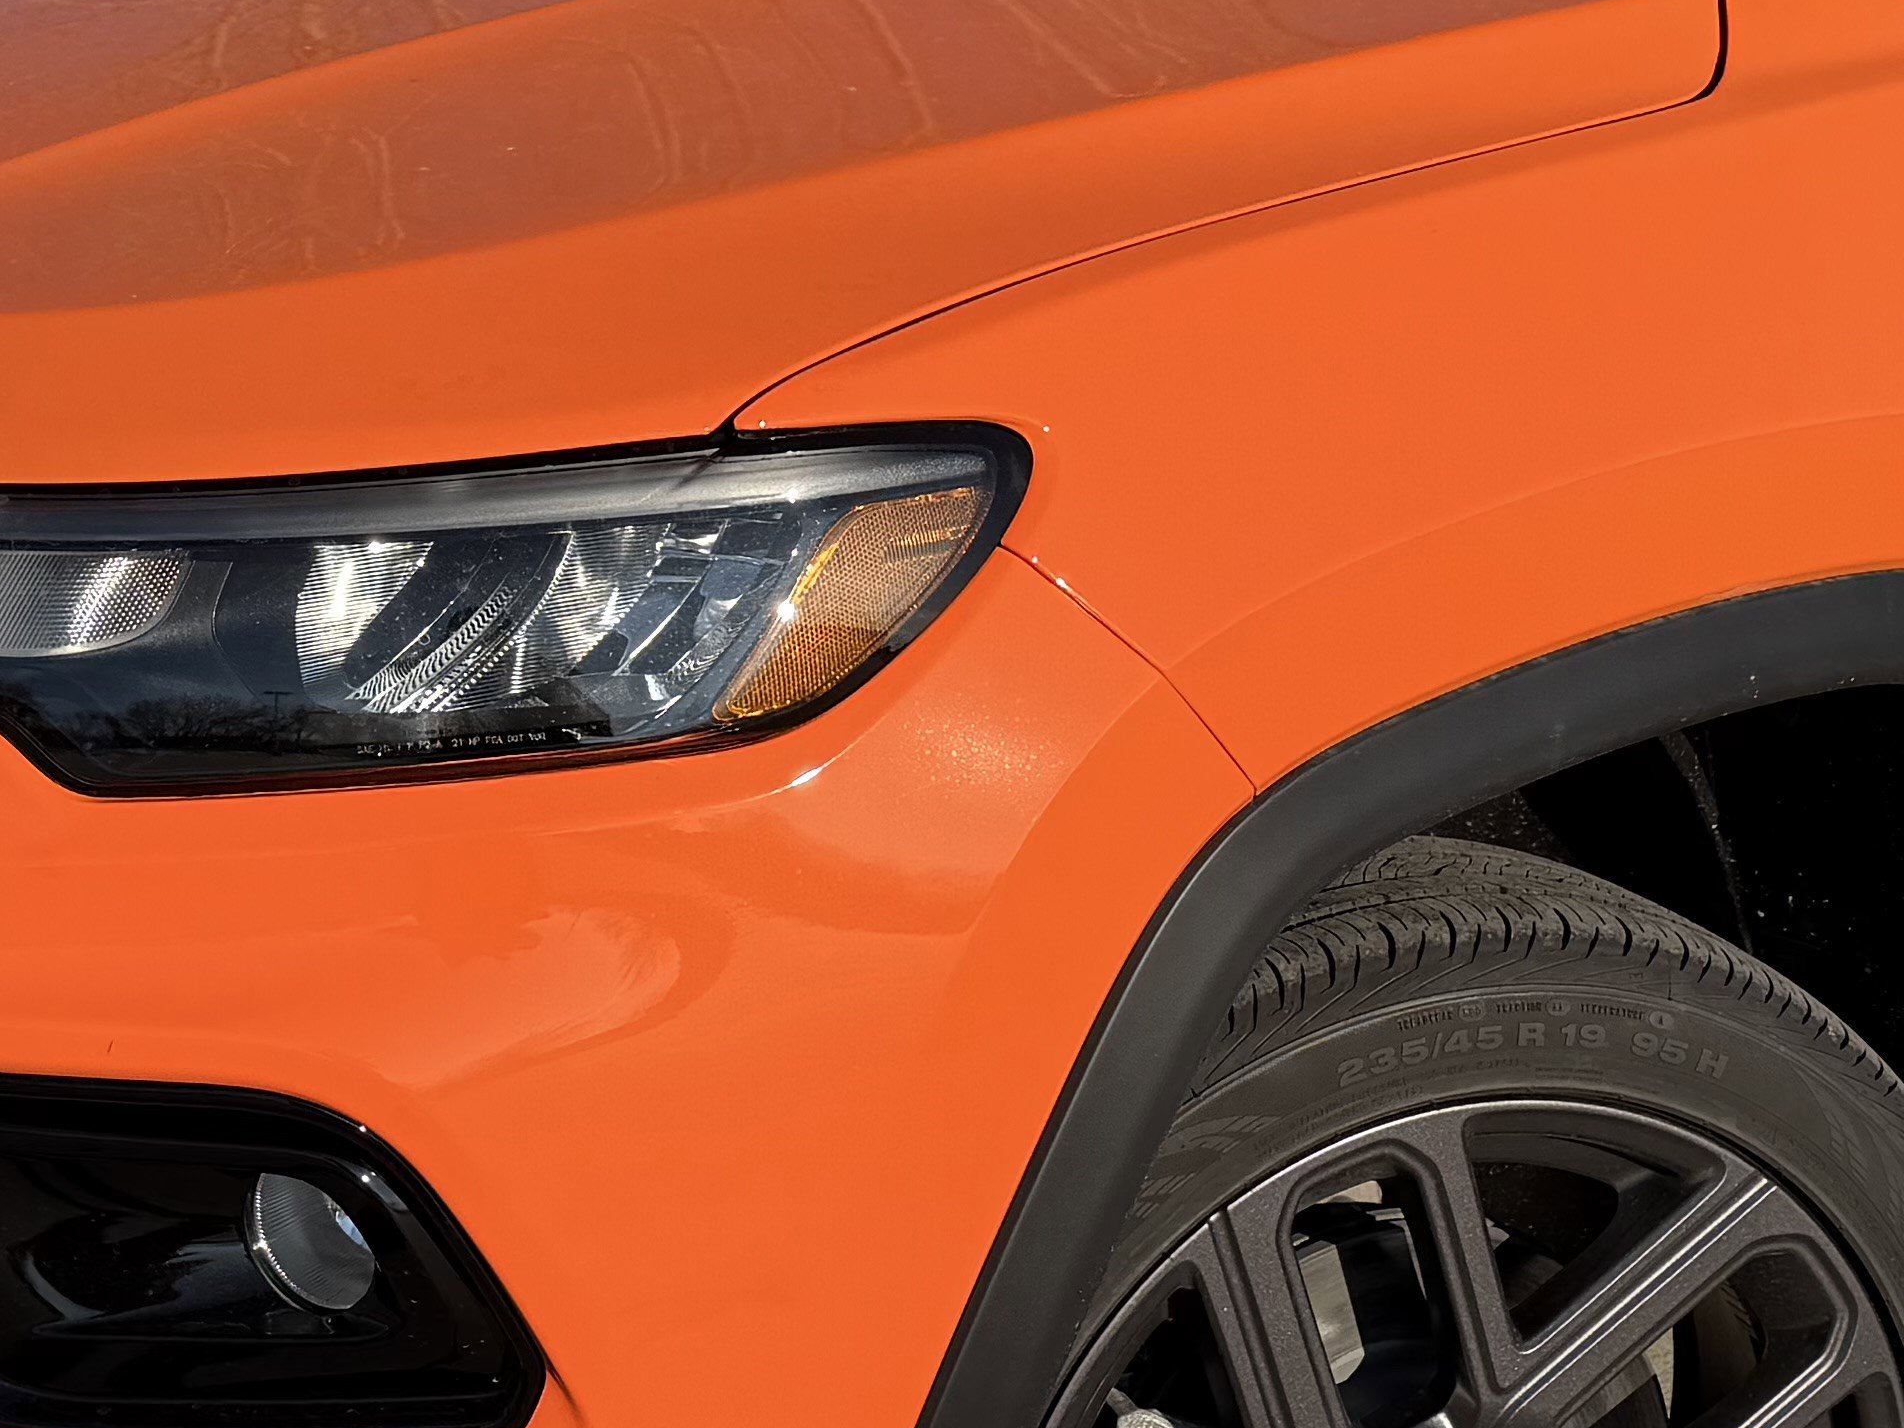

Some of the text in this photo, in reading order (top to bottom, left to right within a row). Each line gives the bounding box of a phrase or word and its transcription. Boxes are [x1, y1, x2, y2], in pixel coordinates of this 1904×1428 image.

[1337, 1022, 1504, 1088] 235/45
[1516, 1021, 1546, 1049] R
[1559, 1022, 1609, 1049] 19
